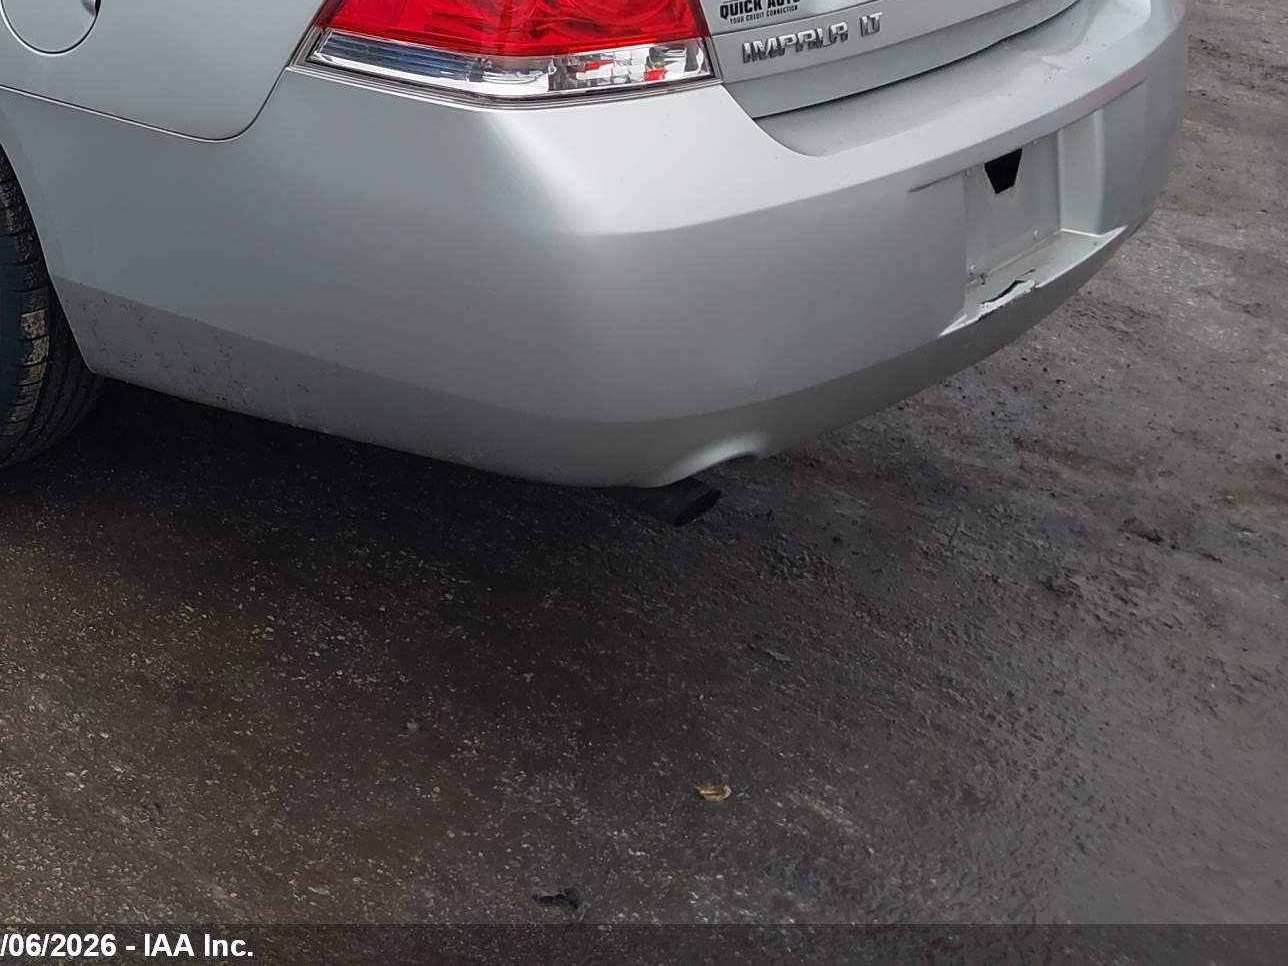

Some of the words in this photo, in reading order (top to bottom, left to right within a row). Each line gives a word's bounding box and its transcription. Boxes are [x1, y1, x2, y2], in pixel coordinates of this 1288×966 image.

[729, 16, 745, 25] YOUR
[745, 11, 765, 22] CREDIT
[765, 4, 799, 18] CONNECTION
[742, 21, 849, 64] IMPALA
[859, 11, 883, 38] LT
